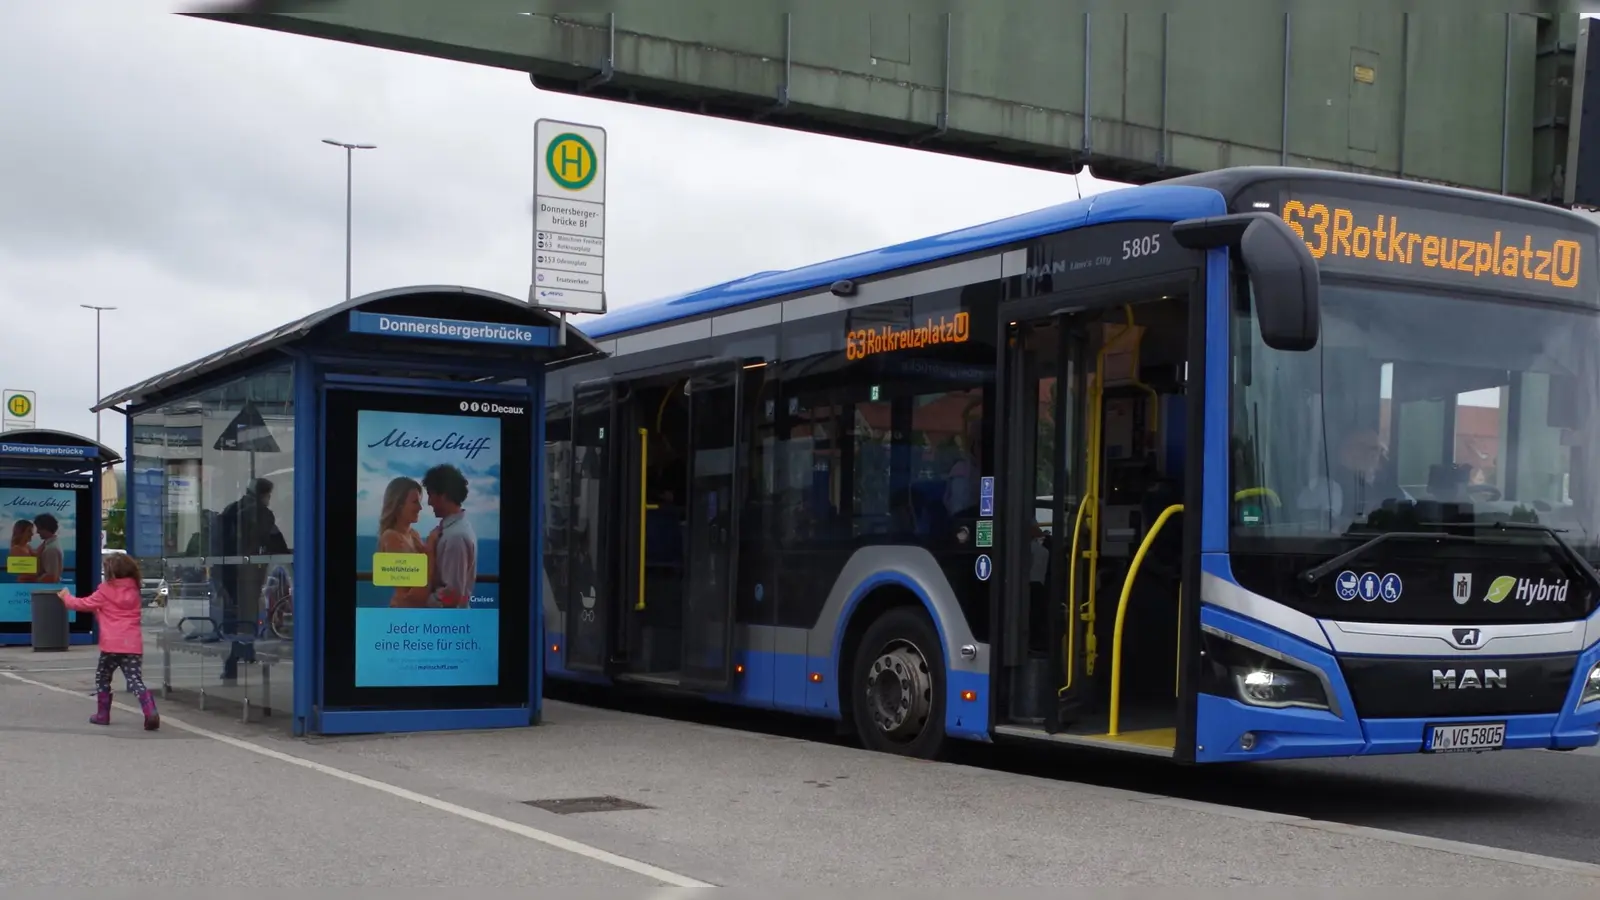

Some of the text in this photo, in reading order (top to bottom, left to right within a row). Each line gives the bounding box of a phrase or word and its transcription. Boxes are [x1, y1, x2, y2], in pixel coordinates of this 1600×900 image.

[562, 145, 582, 178] H
[541, 204, 599, 219] Donnersberger-
[552, 215, 577, 227] brücke
[1122, 234, 1160, 260] 5805
[1332, 208, 1550, 281] Rotkreuzplatz
[379, 317, 532, 342] Donnersbergerbrücke
[847, 330, 866, 360] 63
[867, 315, 954, 354] Rotkreuzplatz
[491, 404, 524, 415] Decaux
[2, 445, 84, 455] Donnersbergerbrücke
[368, 428, 491, 459] Mein Schiff
[4, 496, 70, 511] Mein Schiff
[1516, 578, 1569, 605] Hybrid
[387, 623, 470, 634] Jeder Moment
[375, 639, 481, 651] eine Reise für sich.
[1432, 668, 1507, 690] MAN
[1433, 729, 1444, 747] M
